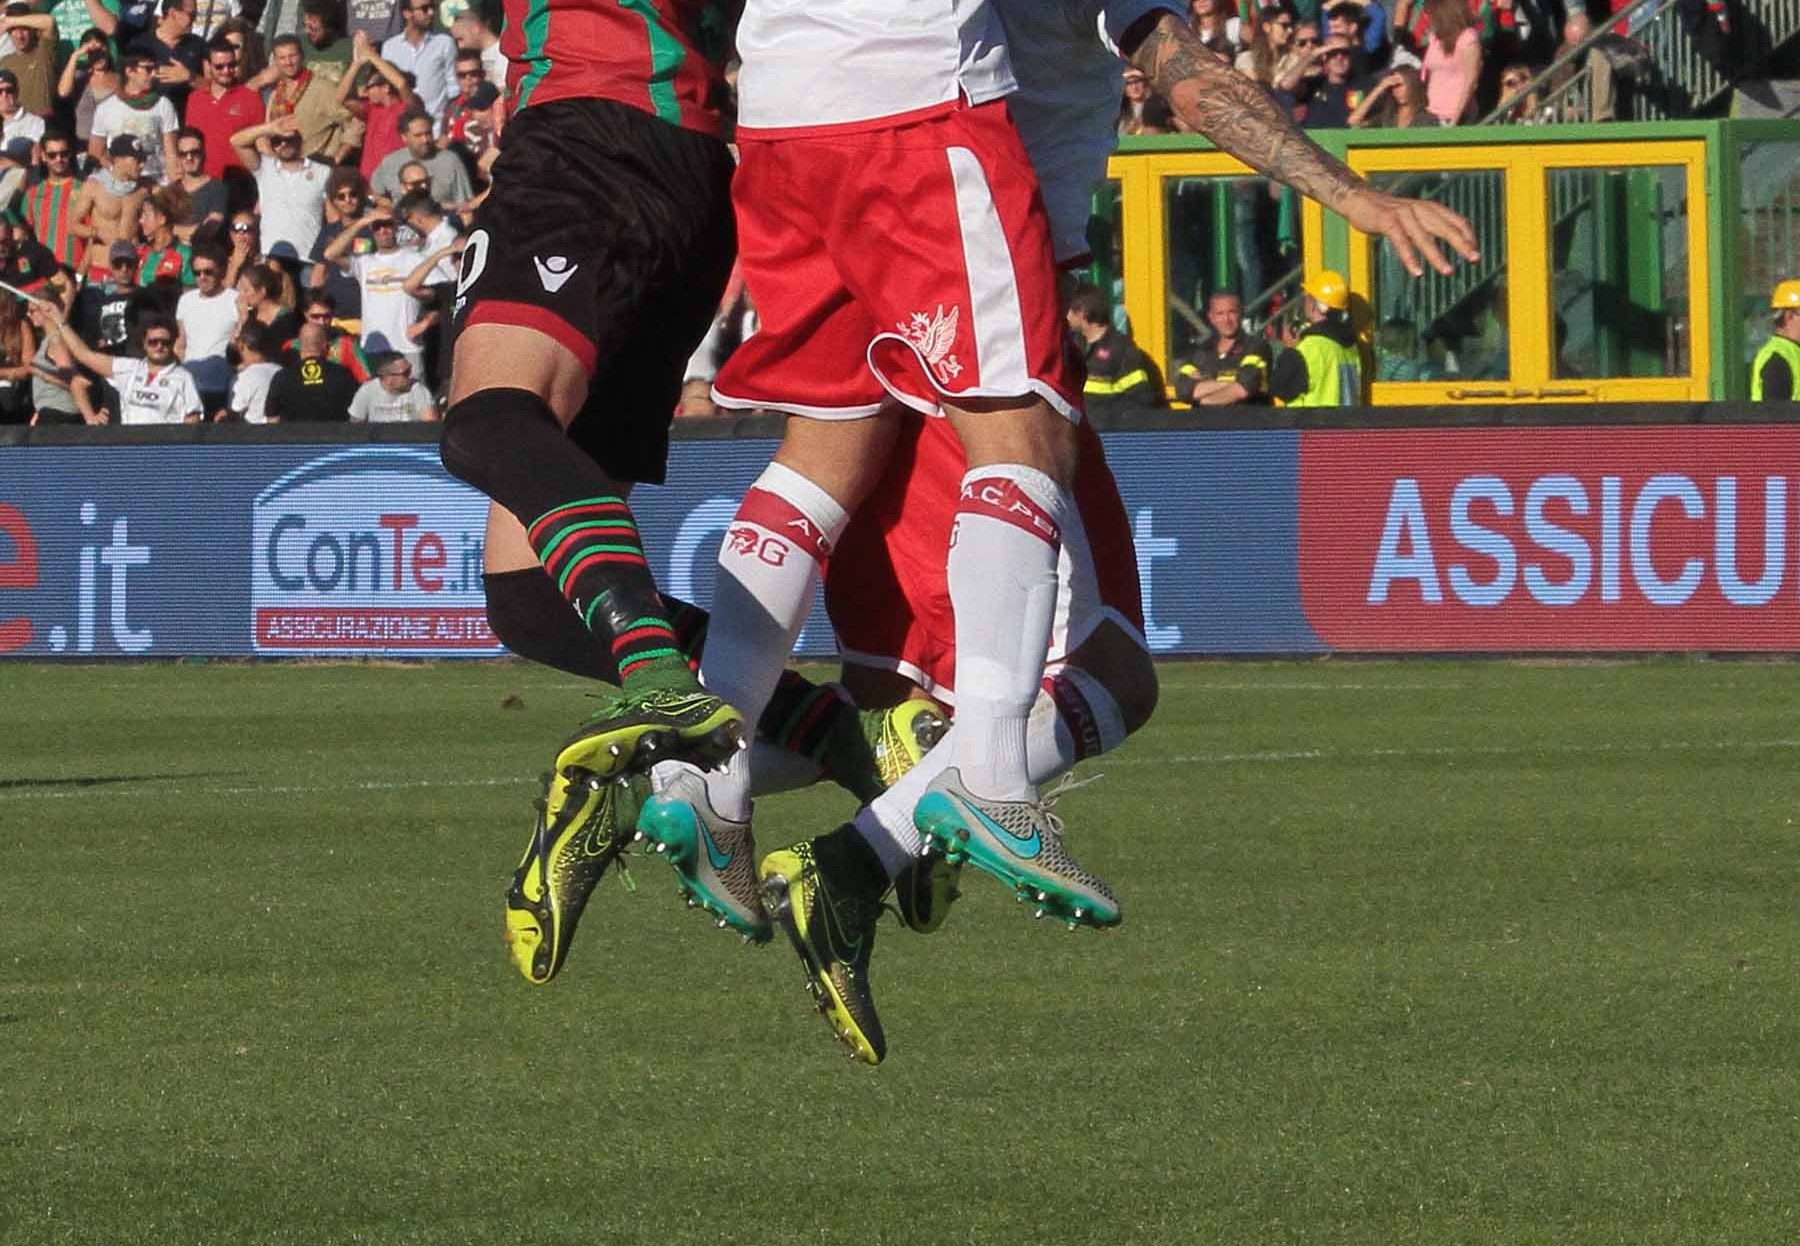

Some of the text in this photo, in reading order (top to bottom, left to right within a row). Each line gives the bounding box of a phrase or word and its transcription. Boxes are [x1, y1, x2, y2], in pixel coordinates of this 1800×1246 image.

[268, 513, 486, 592] ConTe.it
[1366, 473, 1800, 606] ASSICU
[266, 616, 431, 639] ASSICURAZIONE
